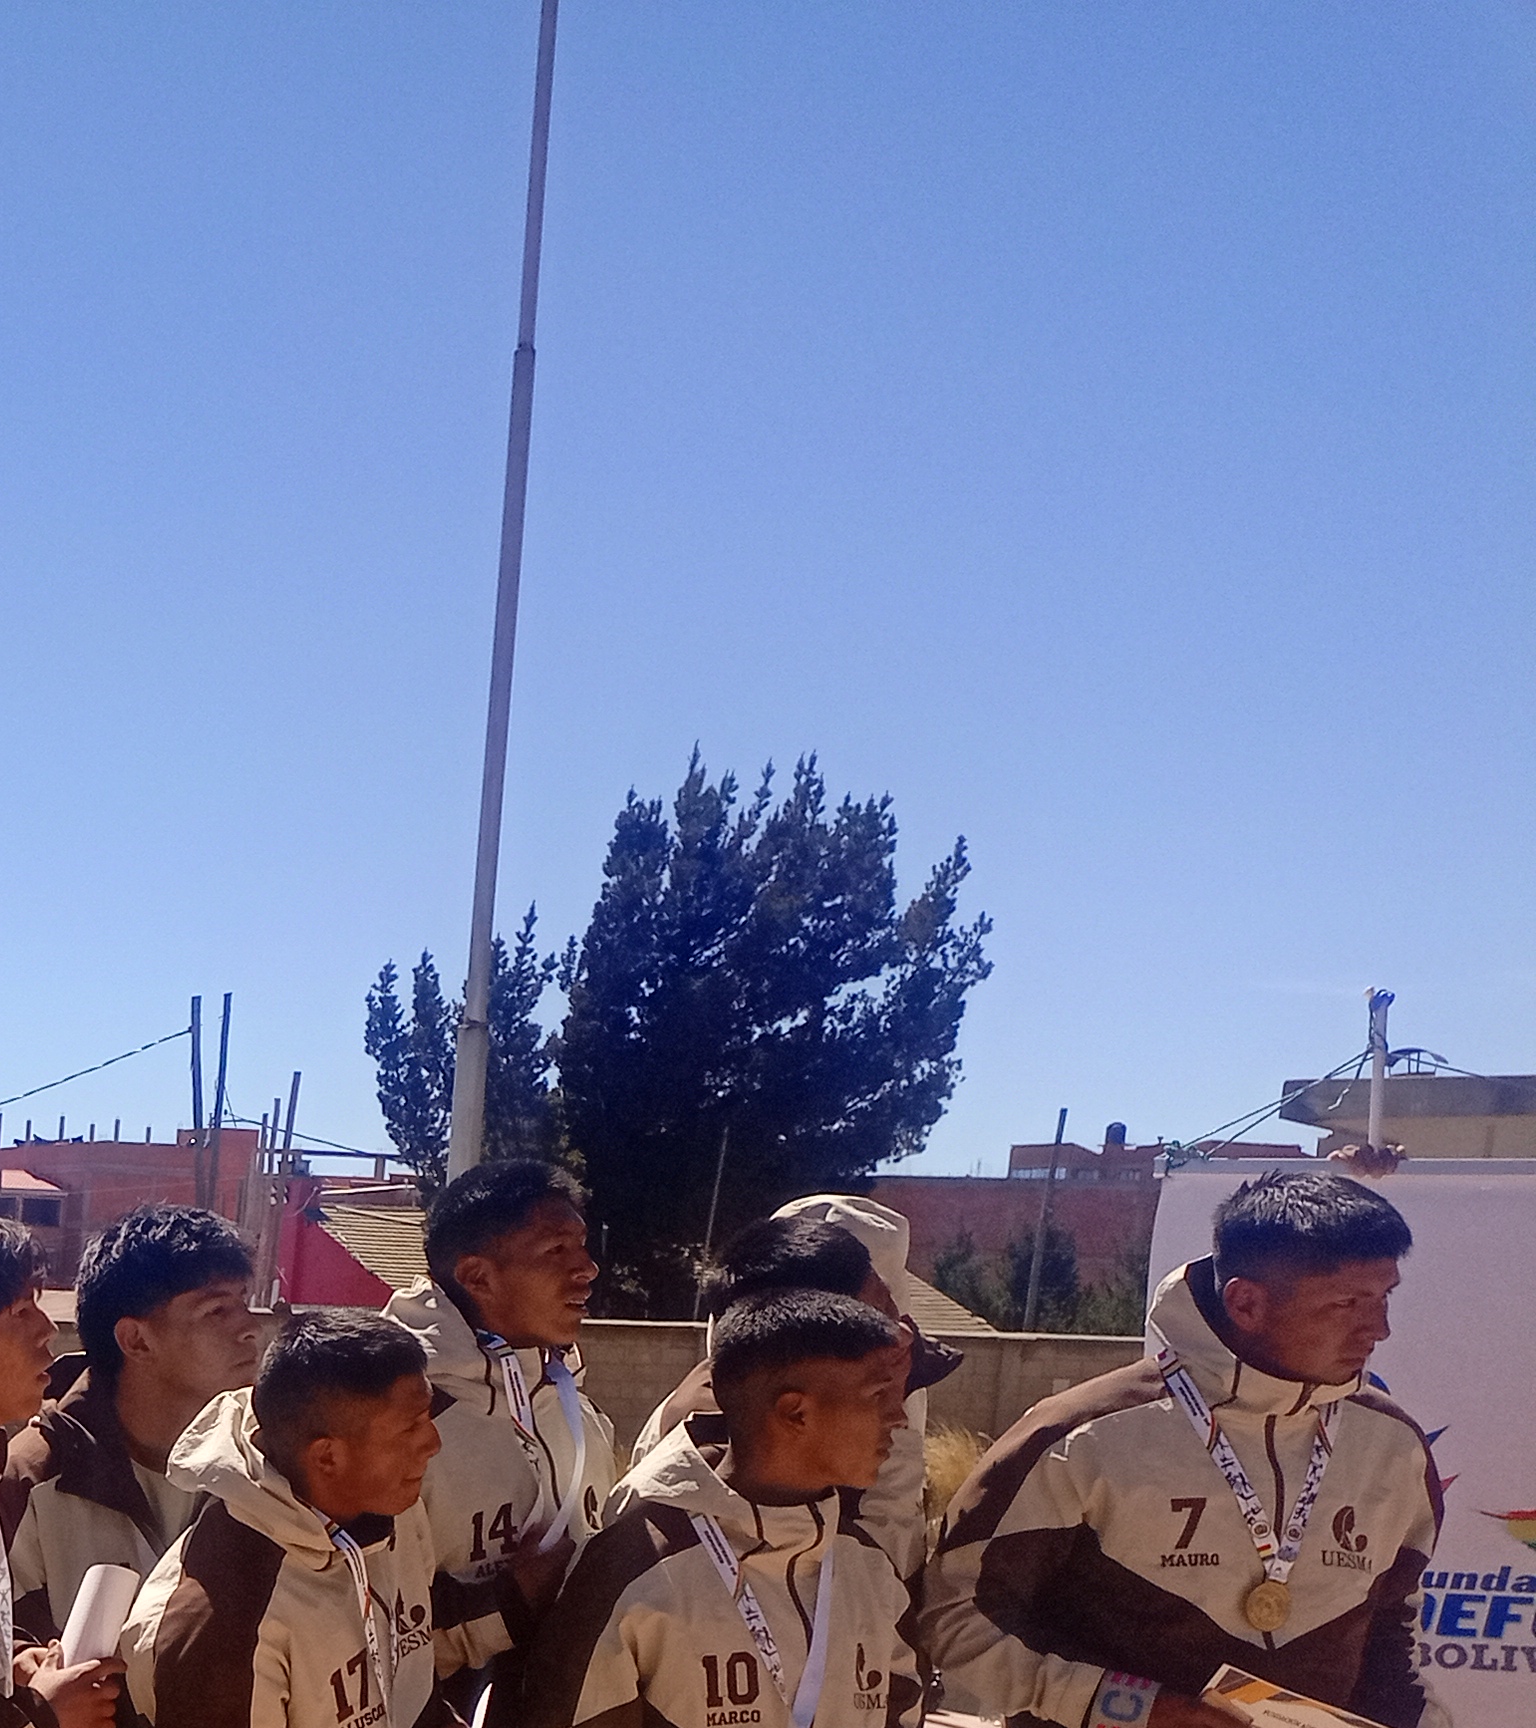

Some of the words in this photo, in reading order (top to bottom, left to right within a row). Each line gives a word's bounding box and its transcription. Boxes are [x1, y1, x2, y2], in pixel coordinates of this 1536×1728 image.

[469, 1502, 518, 1563] 14
[1170, 1497, 1207, 1550] 7
[1160, 1552, 1220, 1568] MAURO
[1422, 1565, 1536, 1594] unda
[330, 1647, 369, 1724] 17
[702, 1651, 760, 1708] 10
[706, 1709, 761, 1728] MARCO
